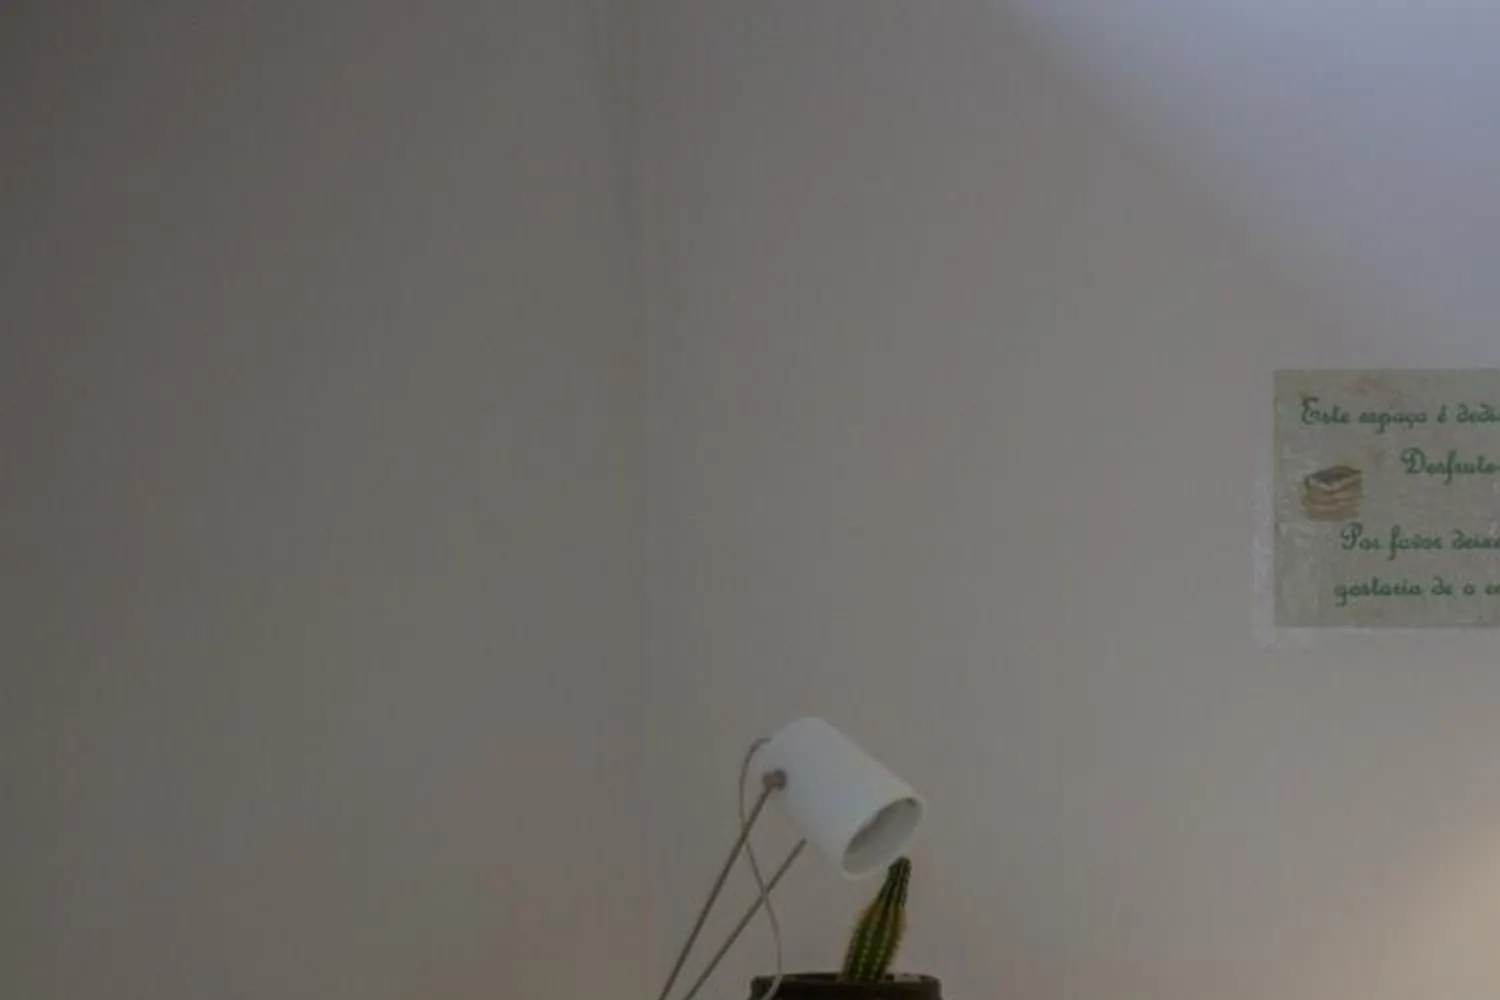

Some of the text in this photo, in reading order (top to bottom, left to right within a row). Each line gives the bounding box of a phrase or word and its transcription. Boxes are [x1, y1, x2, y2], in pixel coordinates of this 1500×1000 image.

[1300, 396, 1351, 425] Este
[1358, 411, 1428, 434] espaço
[1436, 403, 1448, 424] é
[1340, 521, 1380, 550] Por
[1387, 523, 1443, 561] favor
[1333, 576, 1424, 607] gostaria
[1430, 574, 1456, 596] de
[1462, 583, 1477, 596] o
